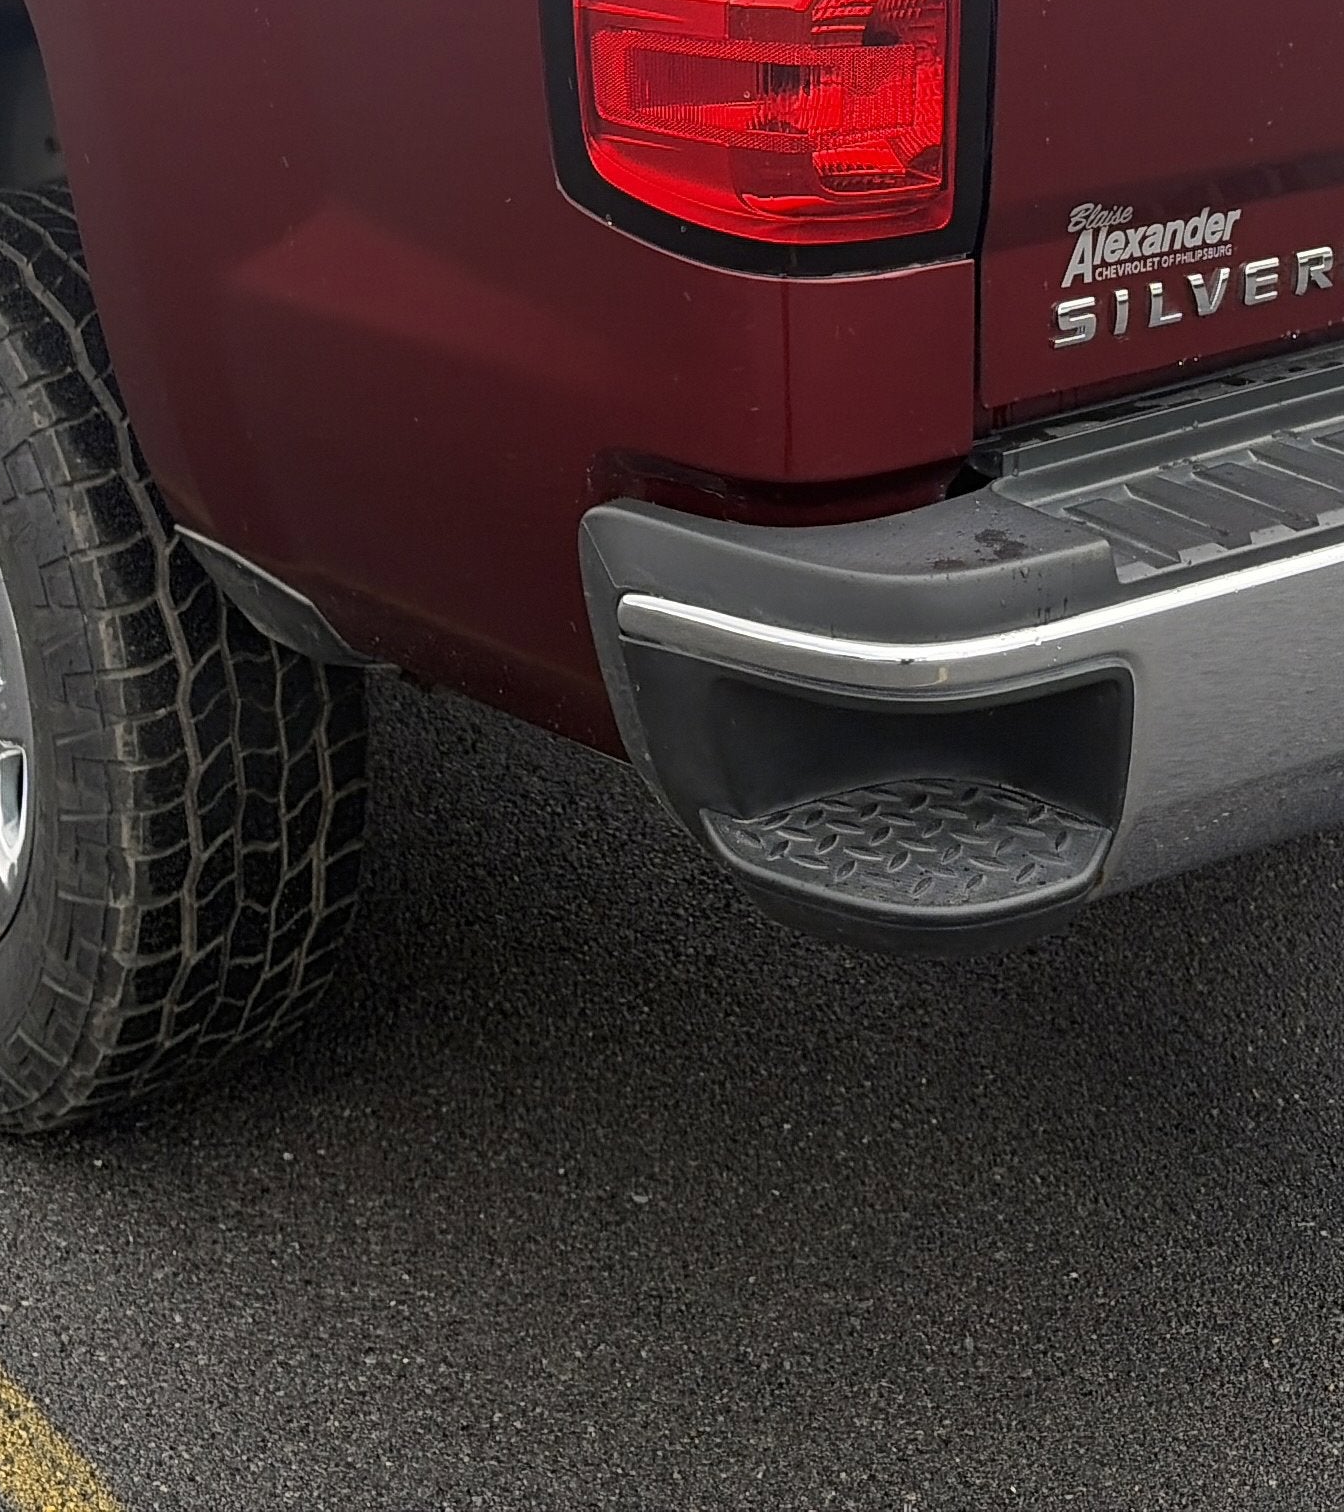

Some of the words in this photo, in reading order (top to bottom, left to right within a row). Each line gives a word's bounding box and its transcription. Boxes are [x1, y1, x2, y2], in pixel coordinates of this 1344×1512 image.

[1067, 202, 1134, 233] Blaise
[1061, 206, 1242, 289] Alexander
[1094, 256, 1159, 281] CHEVROLET
[1161, 253, 1176, 268] OF
[1175, 243, 1233, 265] PHILIPSBURG
